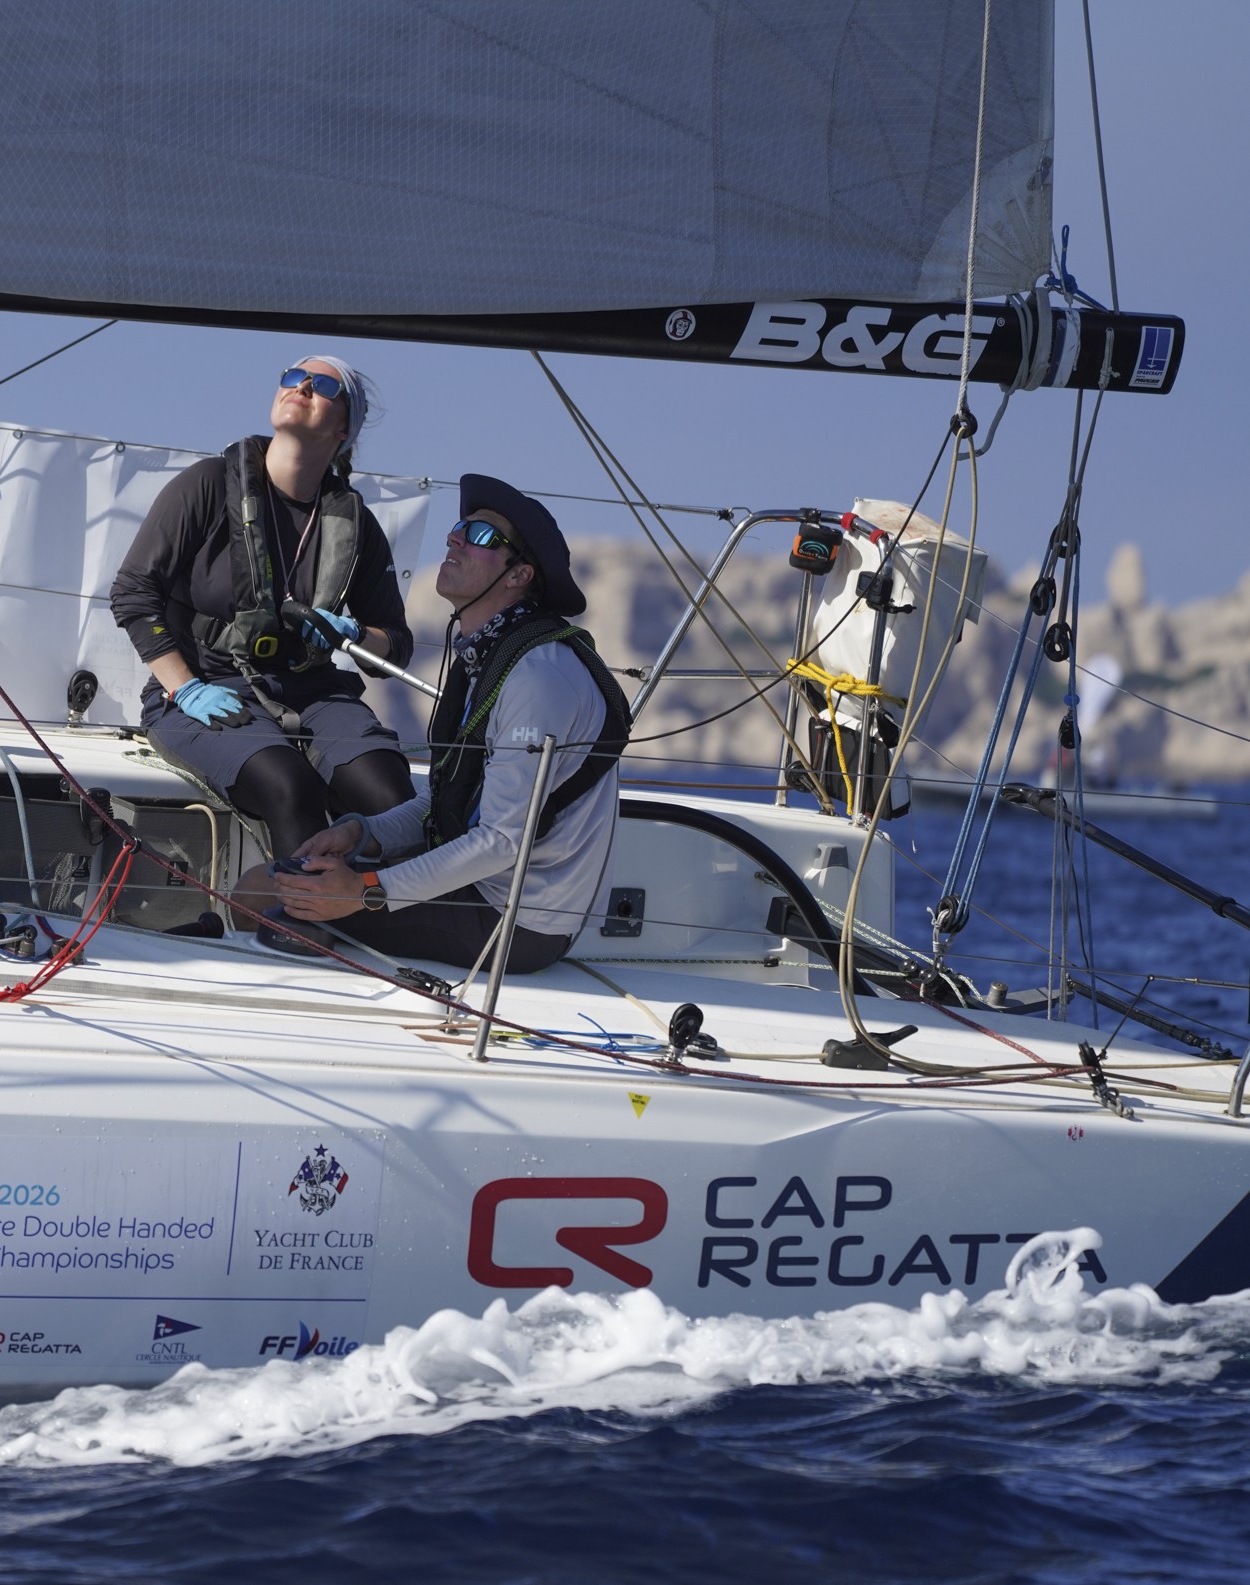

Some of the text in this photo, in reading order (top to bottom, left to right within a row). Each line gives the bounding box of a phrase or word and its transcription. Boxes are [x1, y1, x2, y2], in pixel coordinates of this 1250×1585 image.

[730, 300, 997, 377] B&G
[511, 726, 539, 742] HH
[705, 1175, 893, 1229] CAP
[23, 1215, 111, 1238] Double
[118, 1217, 215, 1239] Handed
[254, 1229, 374, 1248] YACHT CLUB
[288, 1252, 364, 1271] FRANCE
[697, 1233, 1108, 1288] REGAT
[10, 1332, 45, 1342] CAP
[7, 1343, 82, 1354] REGATTA
[151, 1342, 188, 1355] CNTL
